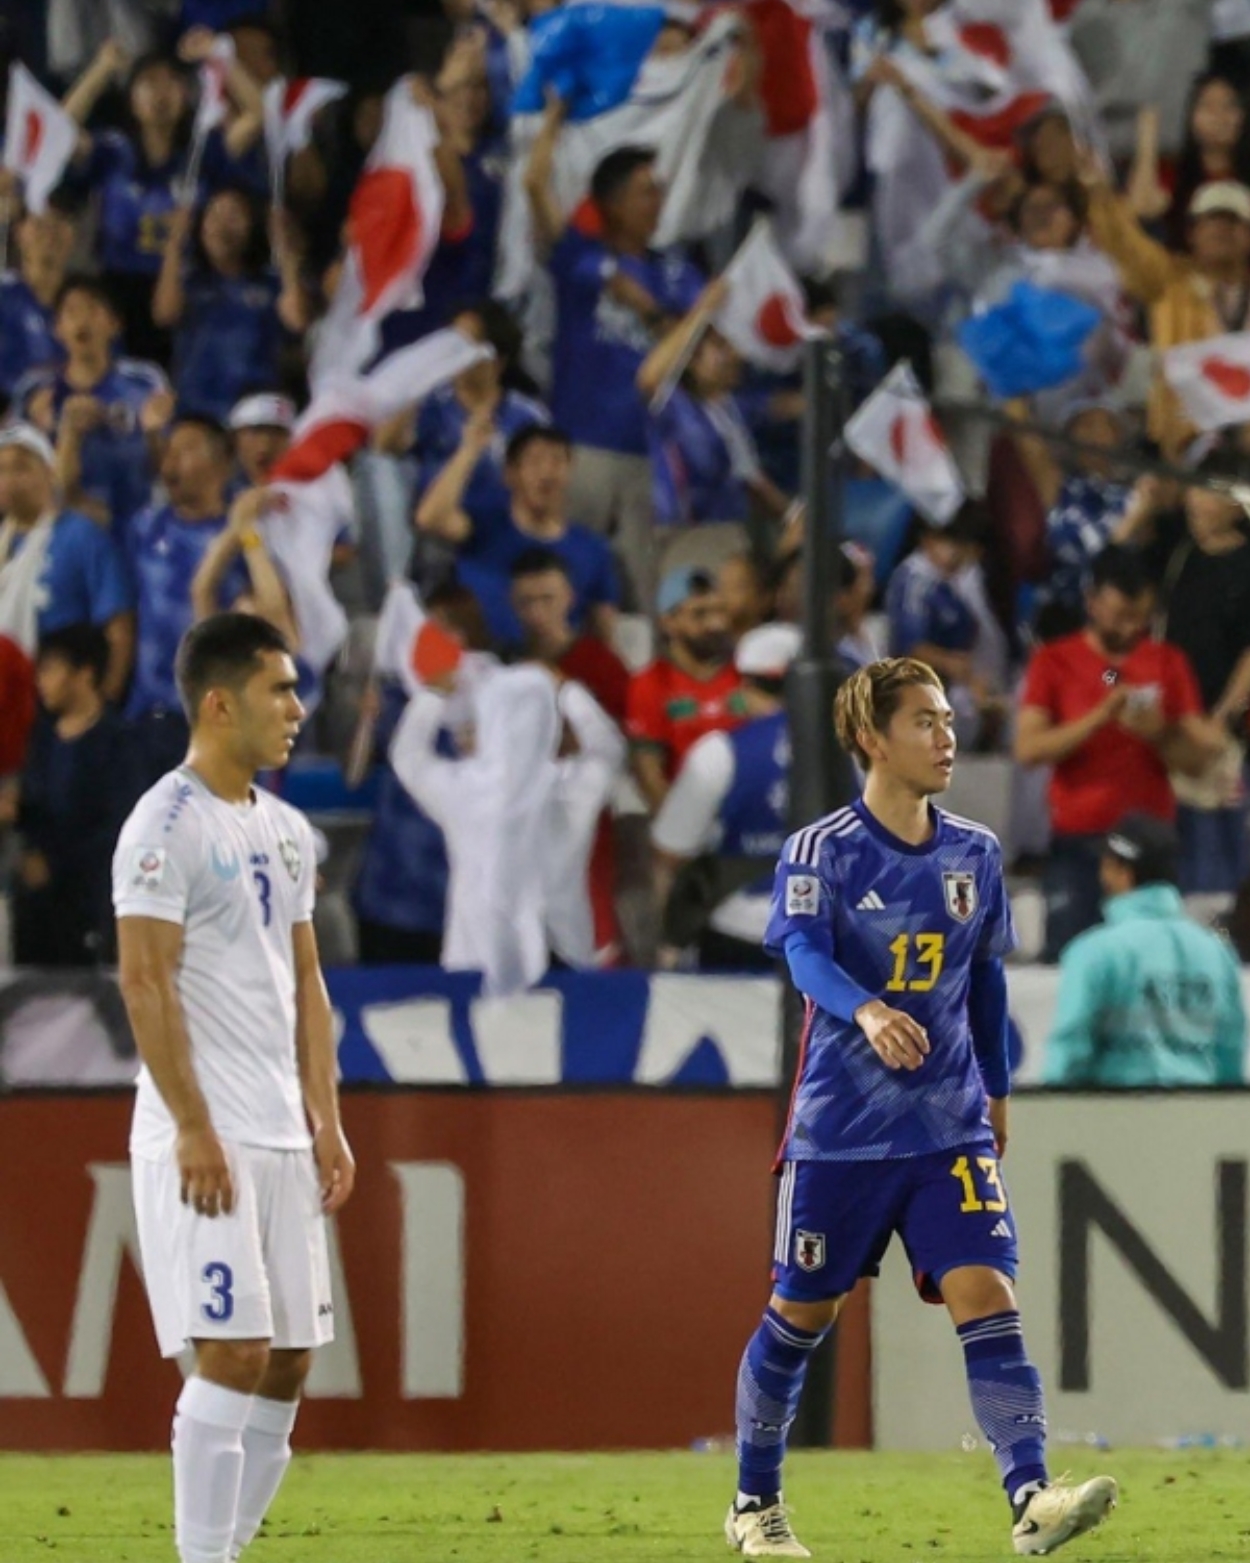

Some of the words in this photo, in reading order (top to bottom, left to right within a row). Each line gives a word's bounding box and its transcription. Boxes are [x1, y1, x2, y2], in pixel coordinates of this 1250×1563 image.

[886, 934, 944, 991] 13
[951, 1156, 1007, 1213] 13
[202, 1261, 234, 1323] 3
